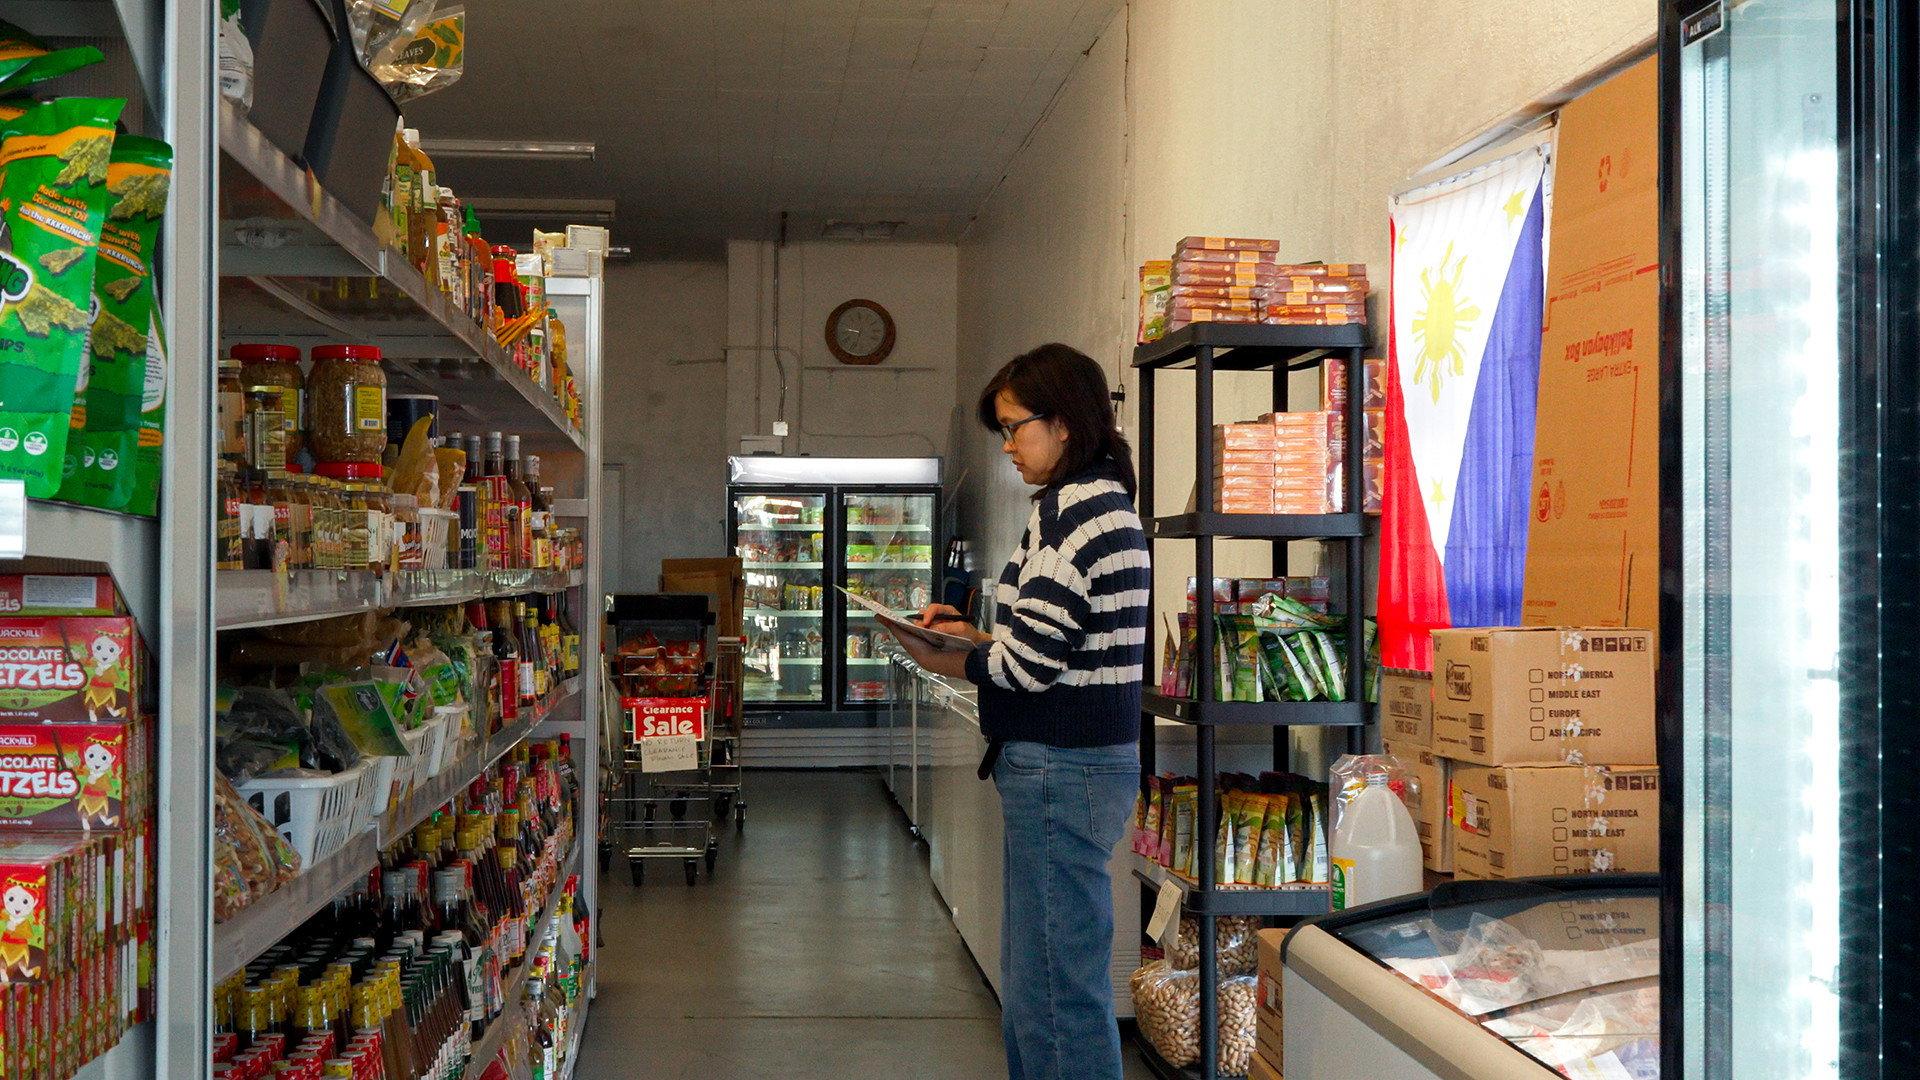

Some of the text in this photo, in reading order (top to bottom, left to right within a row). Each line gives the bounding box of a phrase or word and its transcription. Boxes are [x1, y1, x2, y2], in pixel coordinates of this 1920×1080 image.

[1548, 690, 1601, 698] MIDDLE EAST
[643, 706, 693, 714] Clearance
[1549, 709, 1581, 718] EUROPE
[643, 715, 694, 736] Sale
[1569, 728, 1601, 737] PCIFIC
[0, 757, 55, 769] COLATE
[1601, 809, 1639, 818] AMERICA
[1605, 829, 1625, 838] EAST
